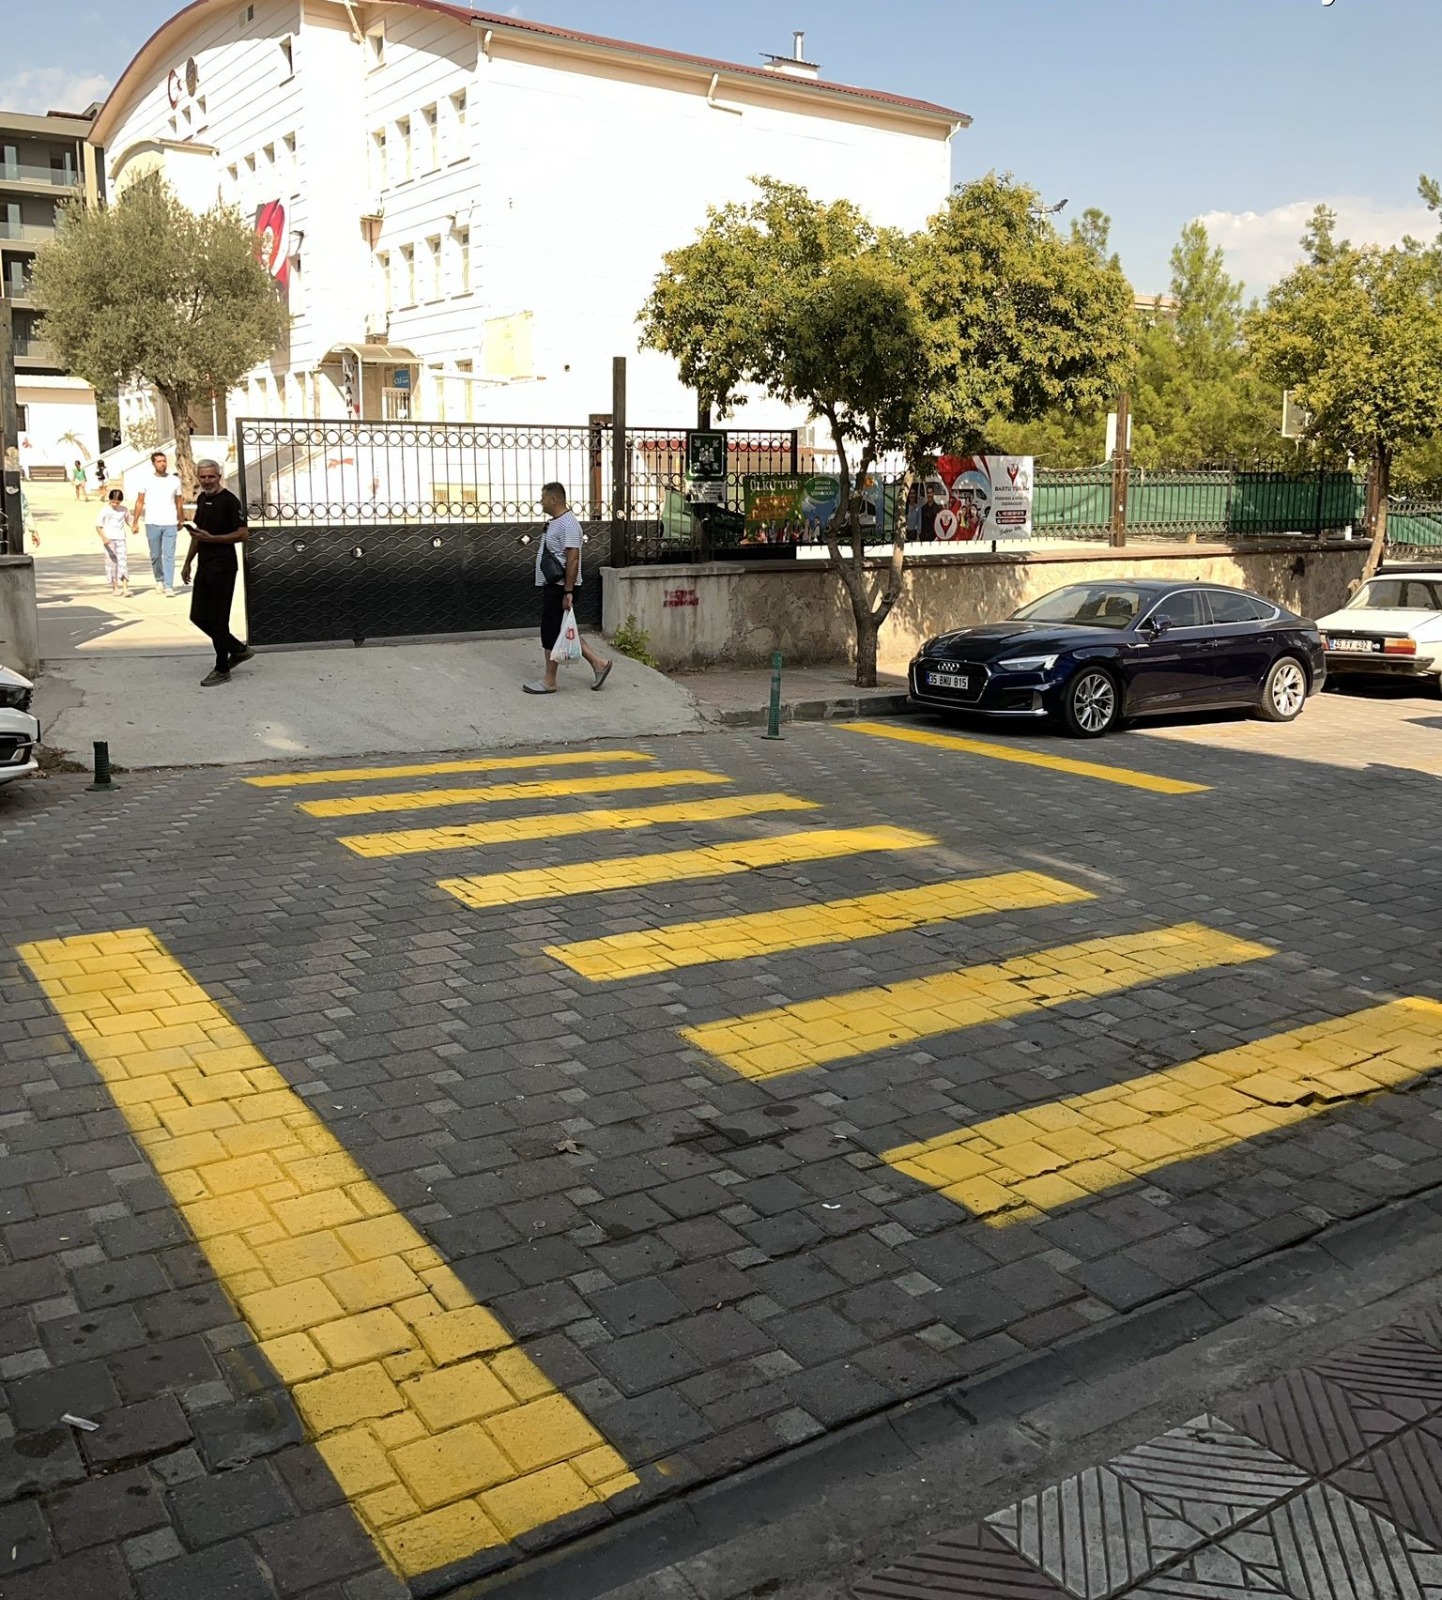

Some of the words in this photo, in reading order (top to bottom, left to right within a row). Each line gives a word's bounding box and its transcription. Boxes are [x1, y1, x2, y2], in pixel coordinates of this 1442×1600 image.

[750, 479, 776, 491] ÜLKÜ
[777, 480, 798, 490] TUR
[929, 674, 937, 684] 35
